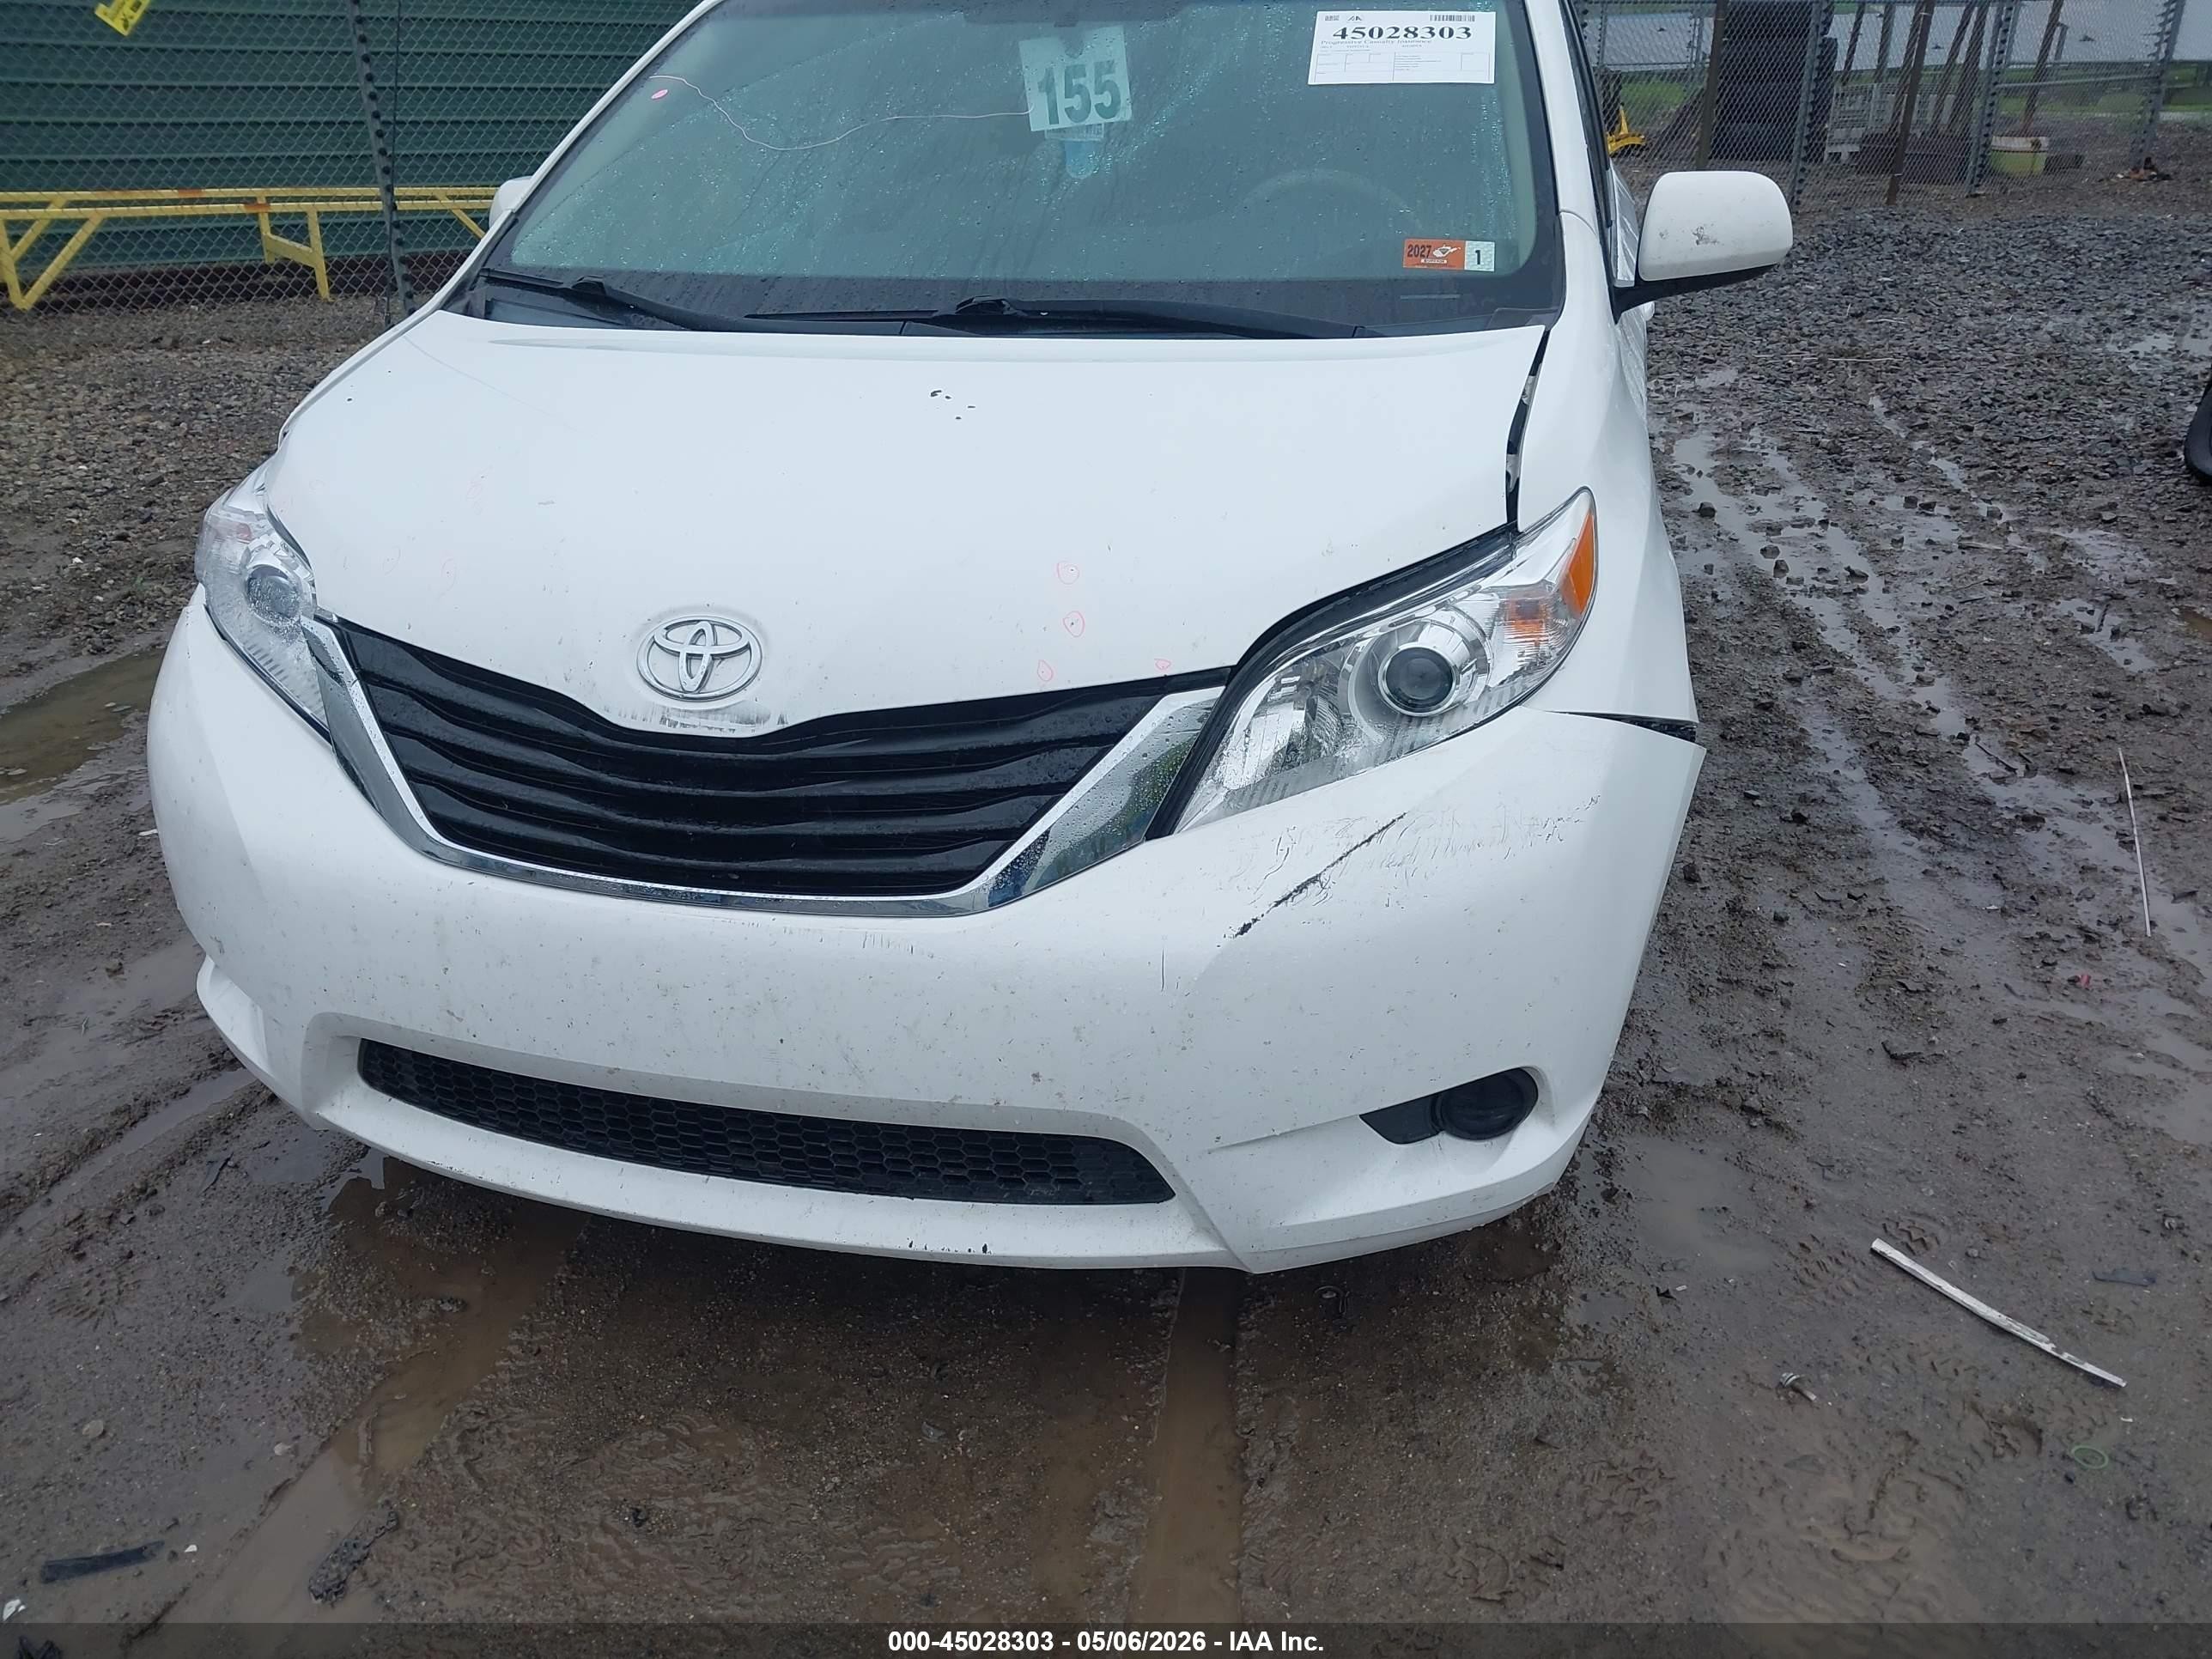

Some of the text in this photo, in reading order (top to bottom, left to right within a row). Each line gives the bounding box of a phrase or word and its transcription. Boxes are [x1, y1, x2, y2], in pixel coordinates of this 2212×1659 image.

[1333, 27, 1472, 40] 45028303
[1037, 59, 1121, 125] 155
[1407, 244, 1481, 265] 2027 1
